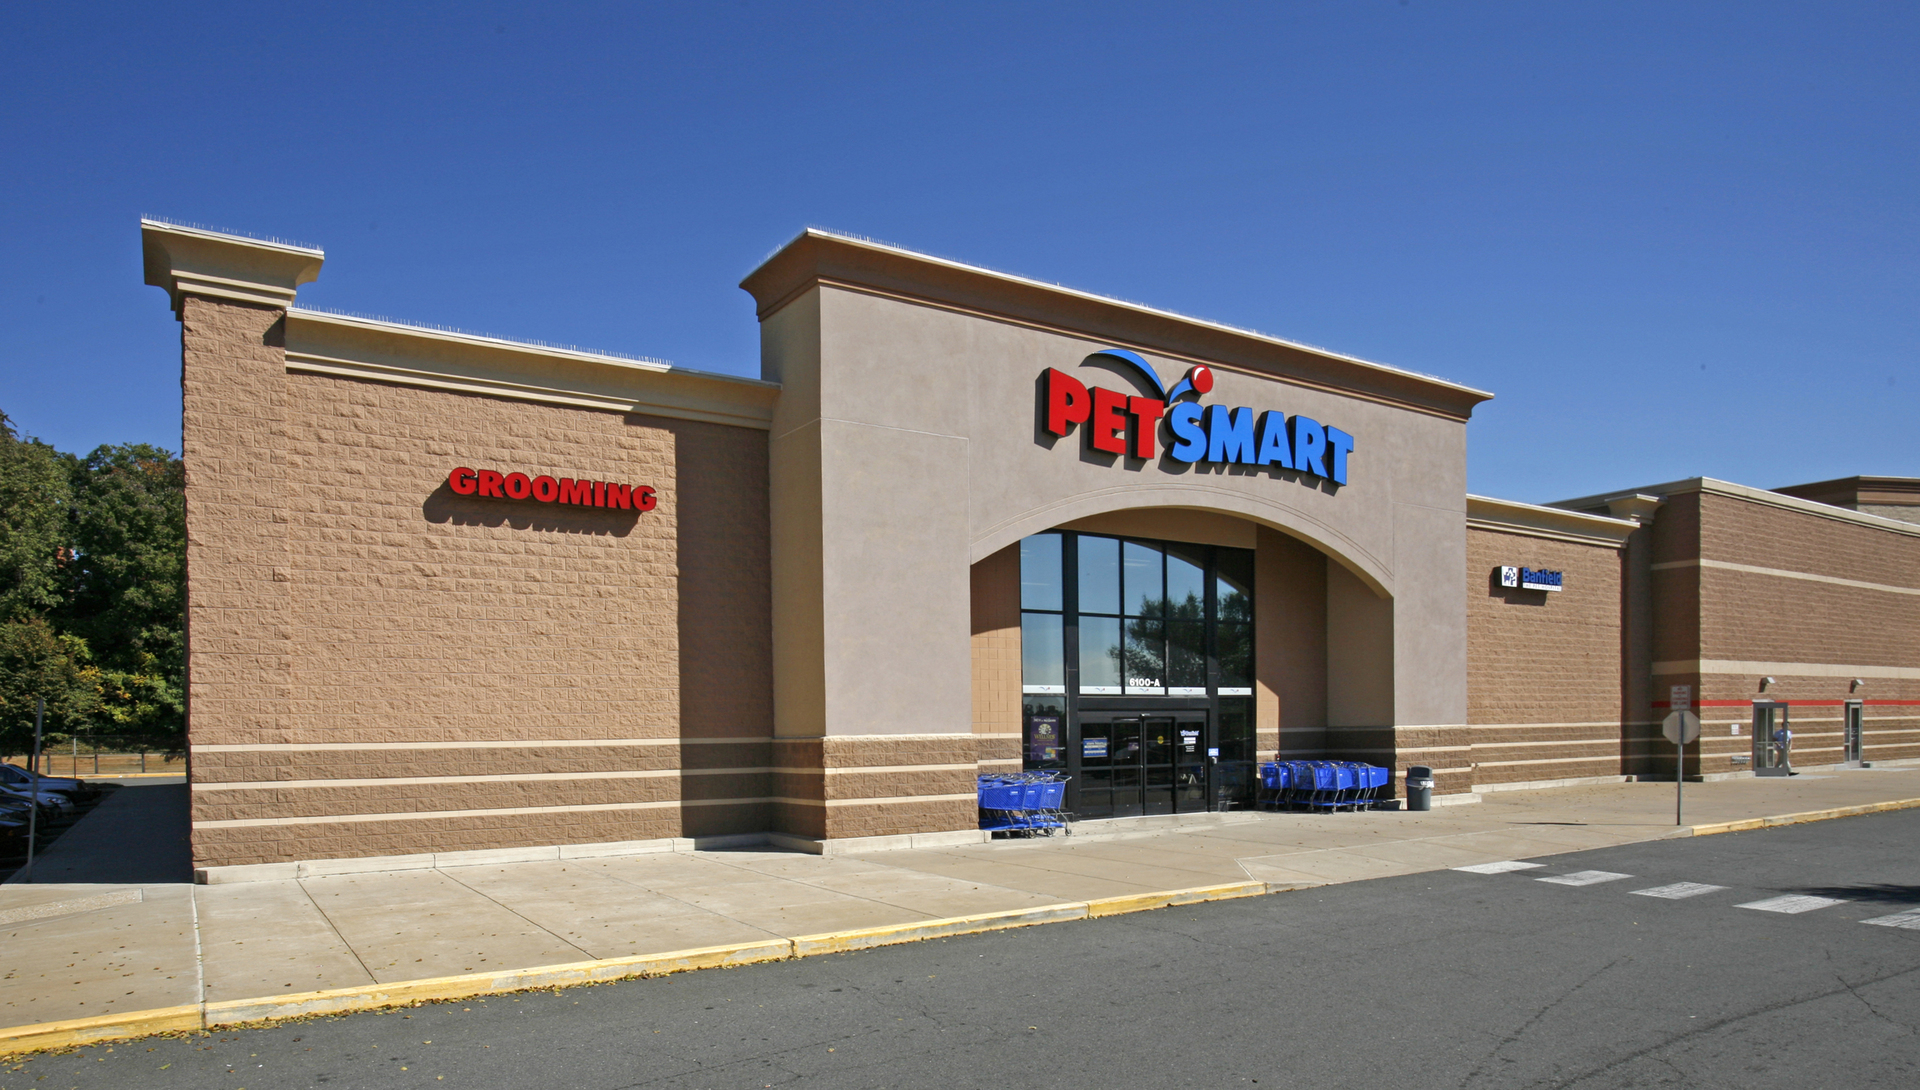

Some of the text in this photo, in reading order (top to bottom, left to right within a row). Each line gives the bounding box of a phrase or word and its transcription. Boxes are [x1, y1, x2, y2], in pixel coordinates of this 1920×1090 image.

[449, 467, 657, 511] GROOMING
[1522, 567, 1562, 586] Banfield
[1129, 678, 1160, 687] 6100-A
